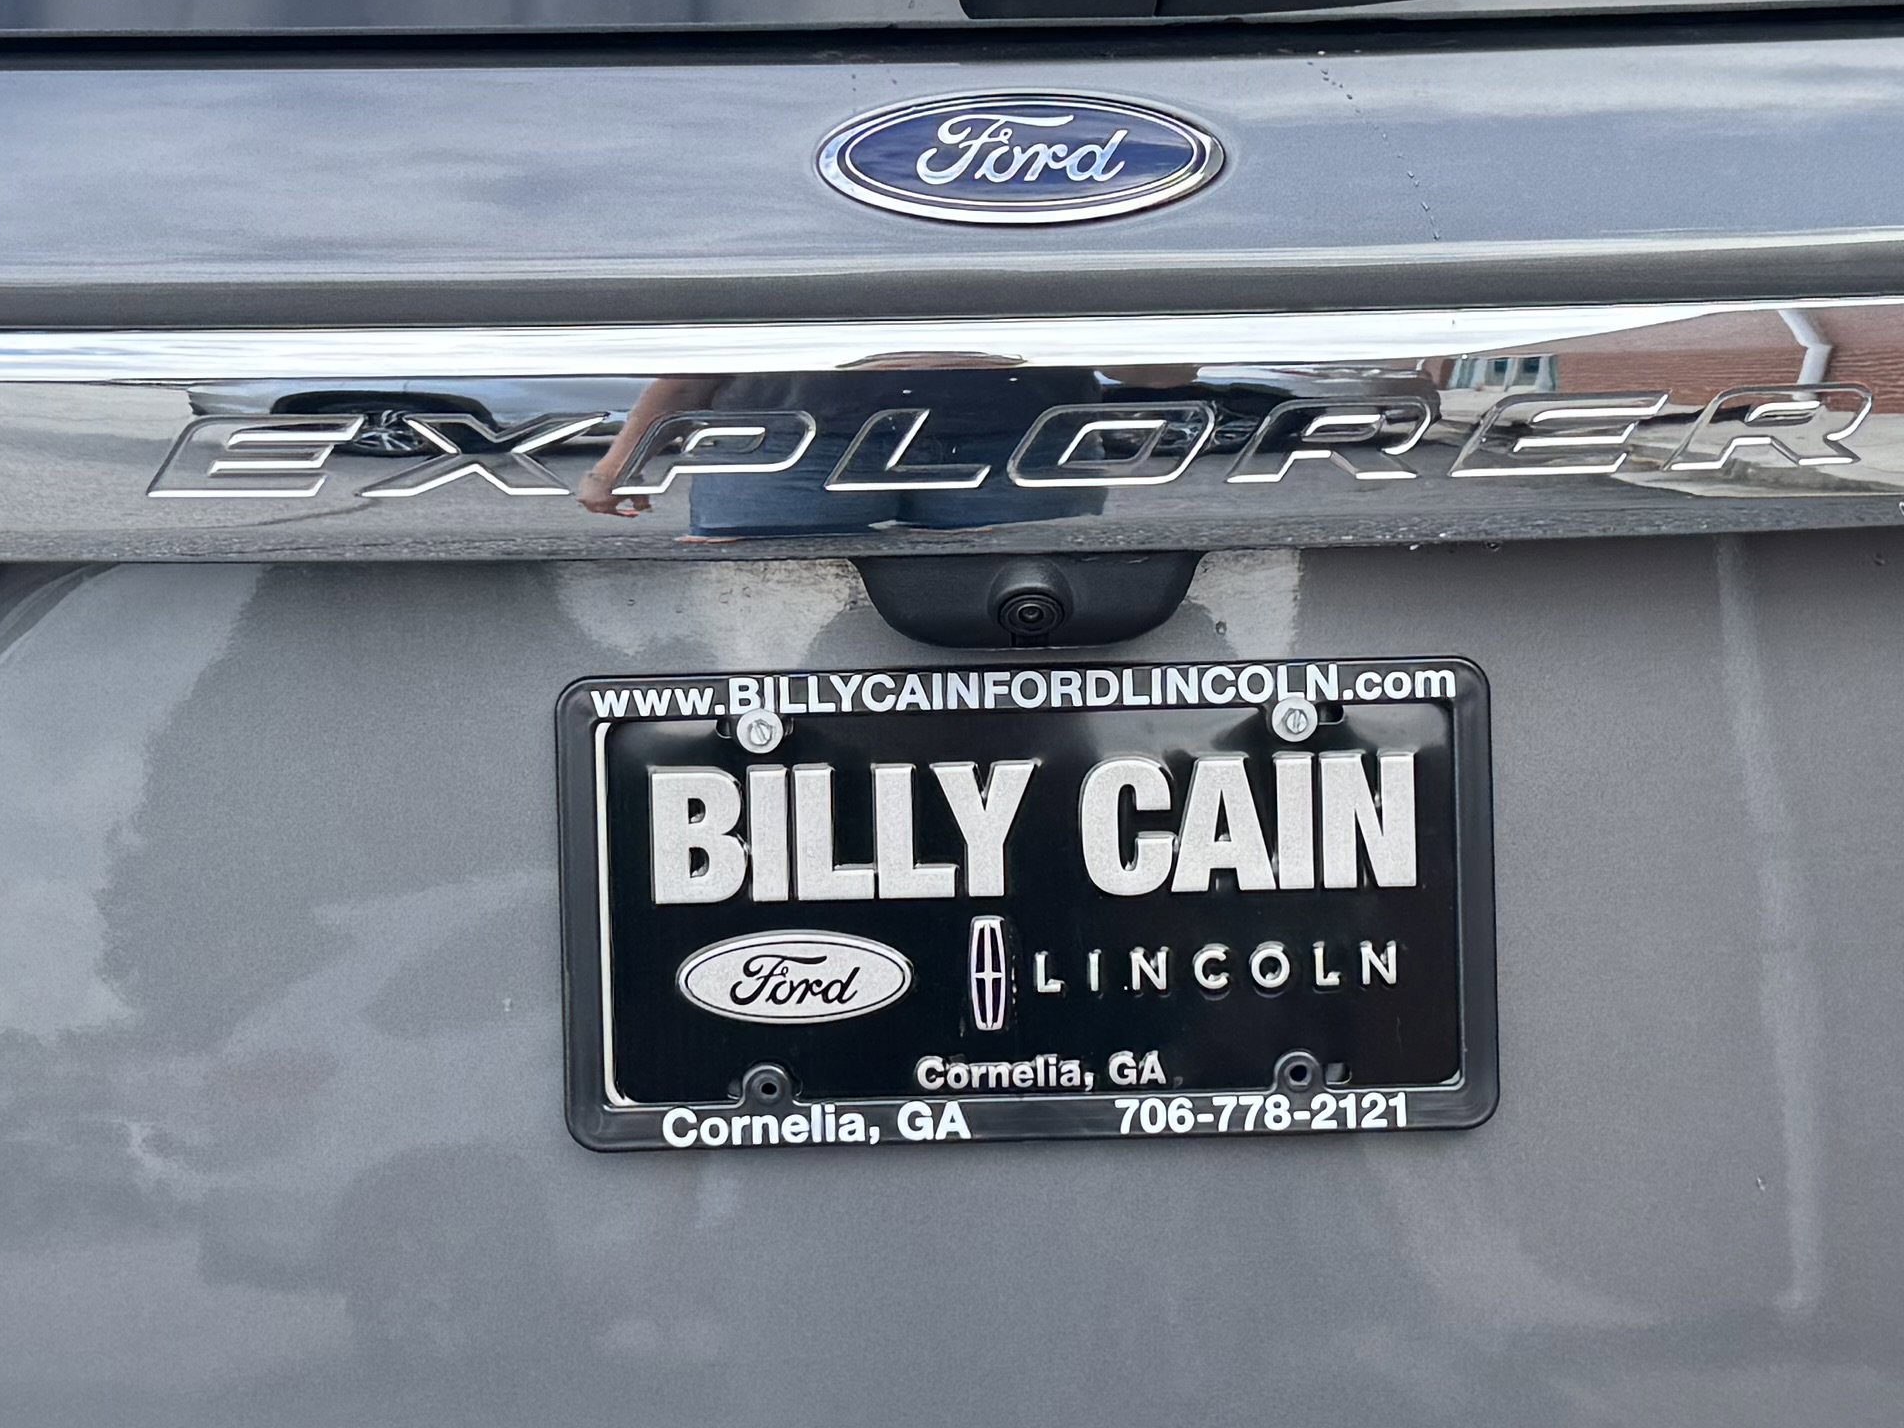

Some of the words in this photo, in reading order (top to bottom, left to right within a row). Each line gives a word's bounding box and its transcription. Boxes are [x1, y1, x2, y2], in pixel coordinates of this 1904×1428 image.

[916, 114, 1128, 185] Ford
[146, 382, 1874, 499] EXPLORER
[590, 663, 1456, 718] www.BILLYCAINFORDLINCOLN.com
[649, 760, 1040, 905] BILLY
[1079, 751, 1419, 897] CAIN
[729, 954, 861, 1006] Ford
[1034, 940, 1398, 994] LINCOLN
[915, 1054, 1095, 1091] Cornelia,
[1108, 1050, 1168, 1086] GA
[662, 1102, 881, 1149] Cornelia,
[896, 1100, 972, 1142] GA
[1114, 1091, 1408, 1135] 706-778-2121
